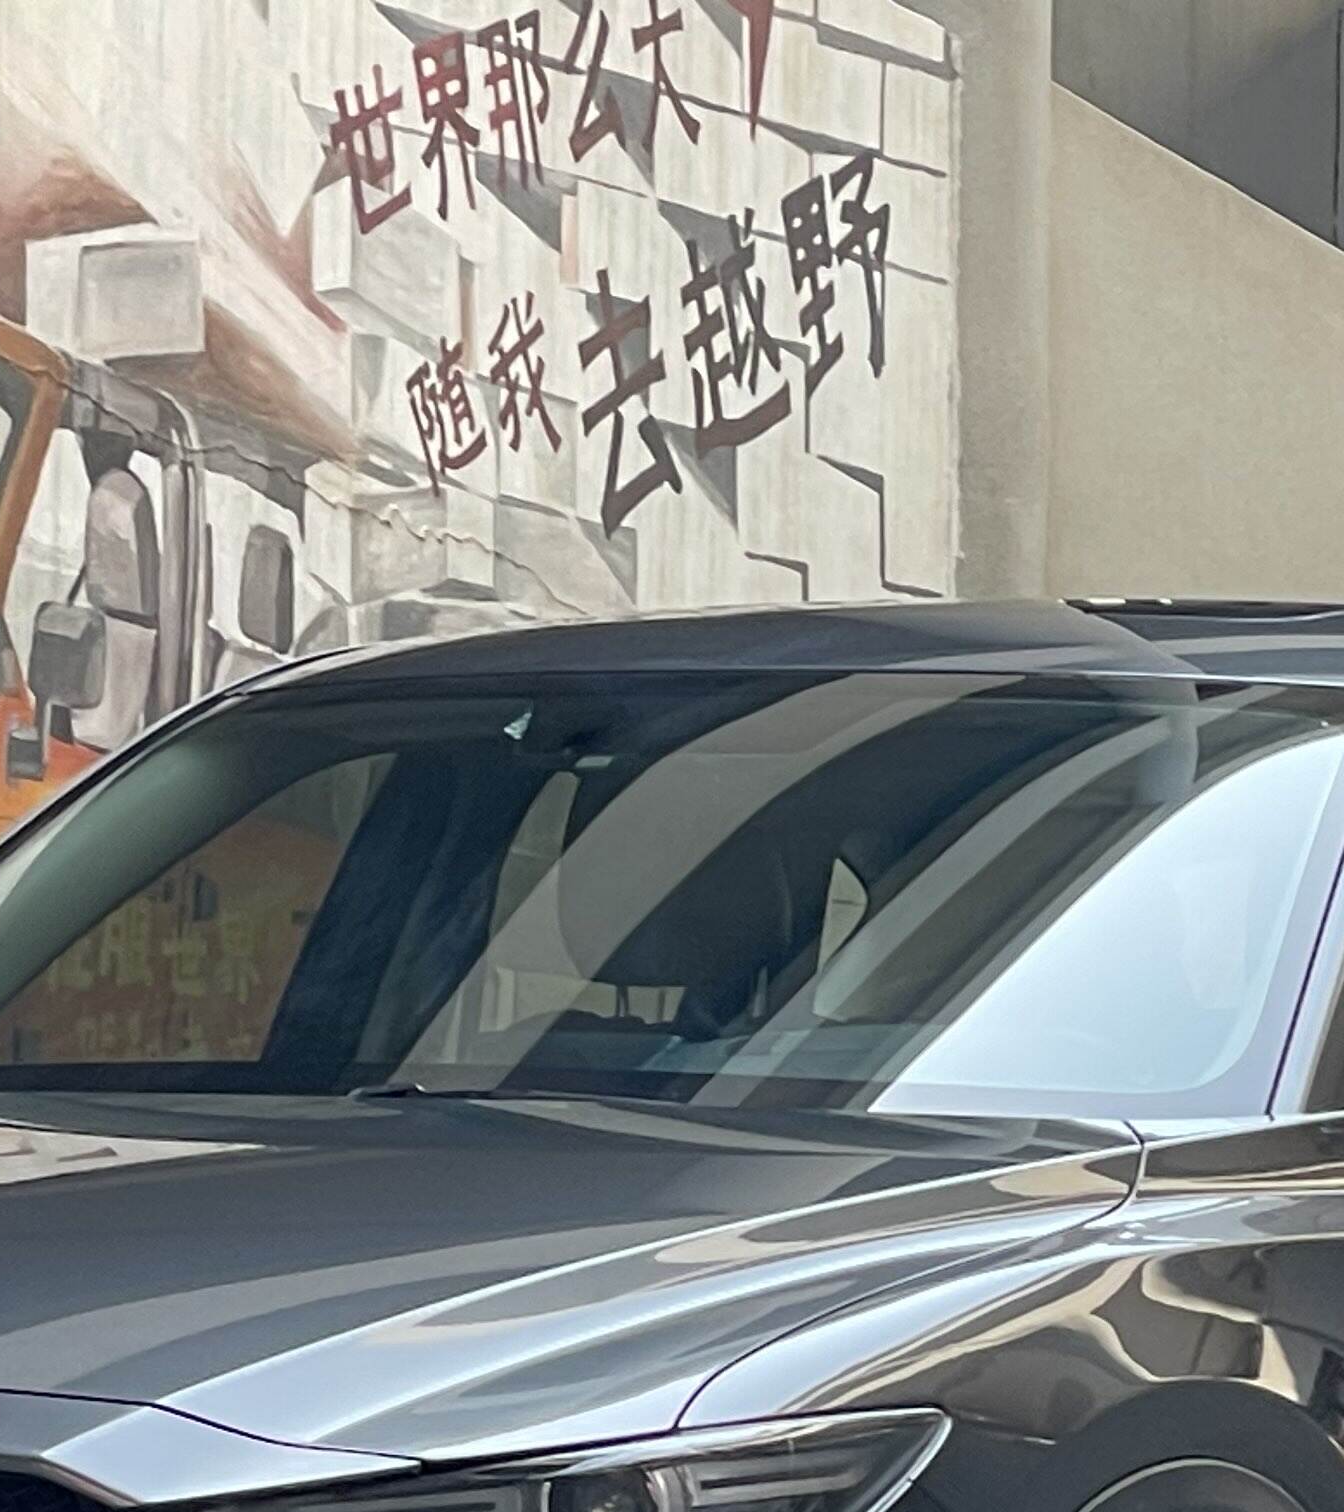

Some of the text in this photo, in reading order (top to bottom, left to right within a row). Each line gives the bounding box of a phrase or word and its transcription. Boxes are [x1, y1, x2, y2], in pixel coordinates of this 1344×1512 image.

[406, 154, 891, 540] 随我去越野
